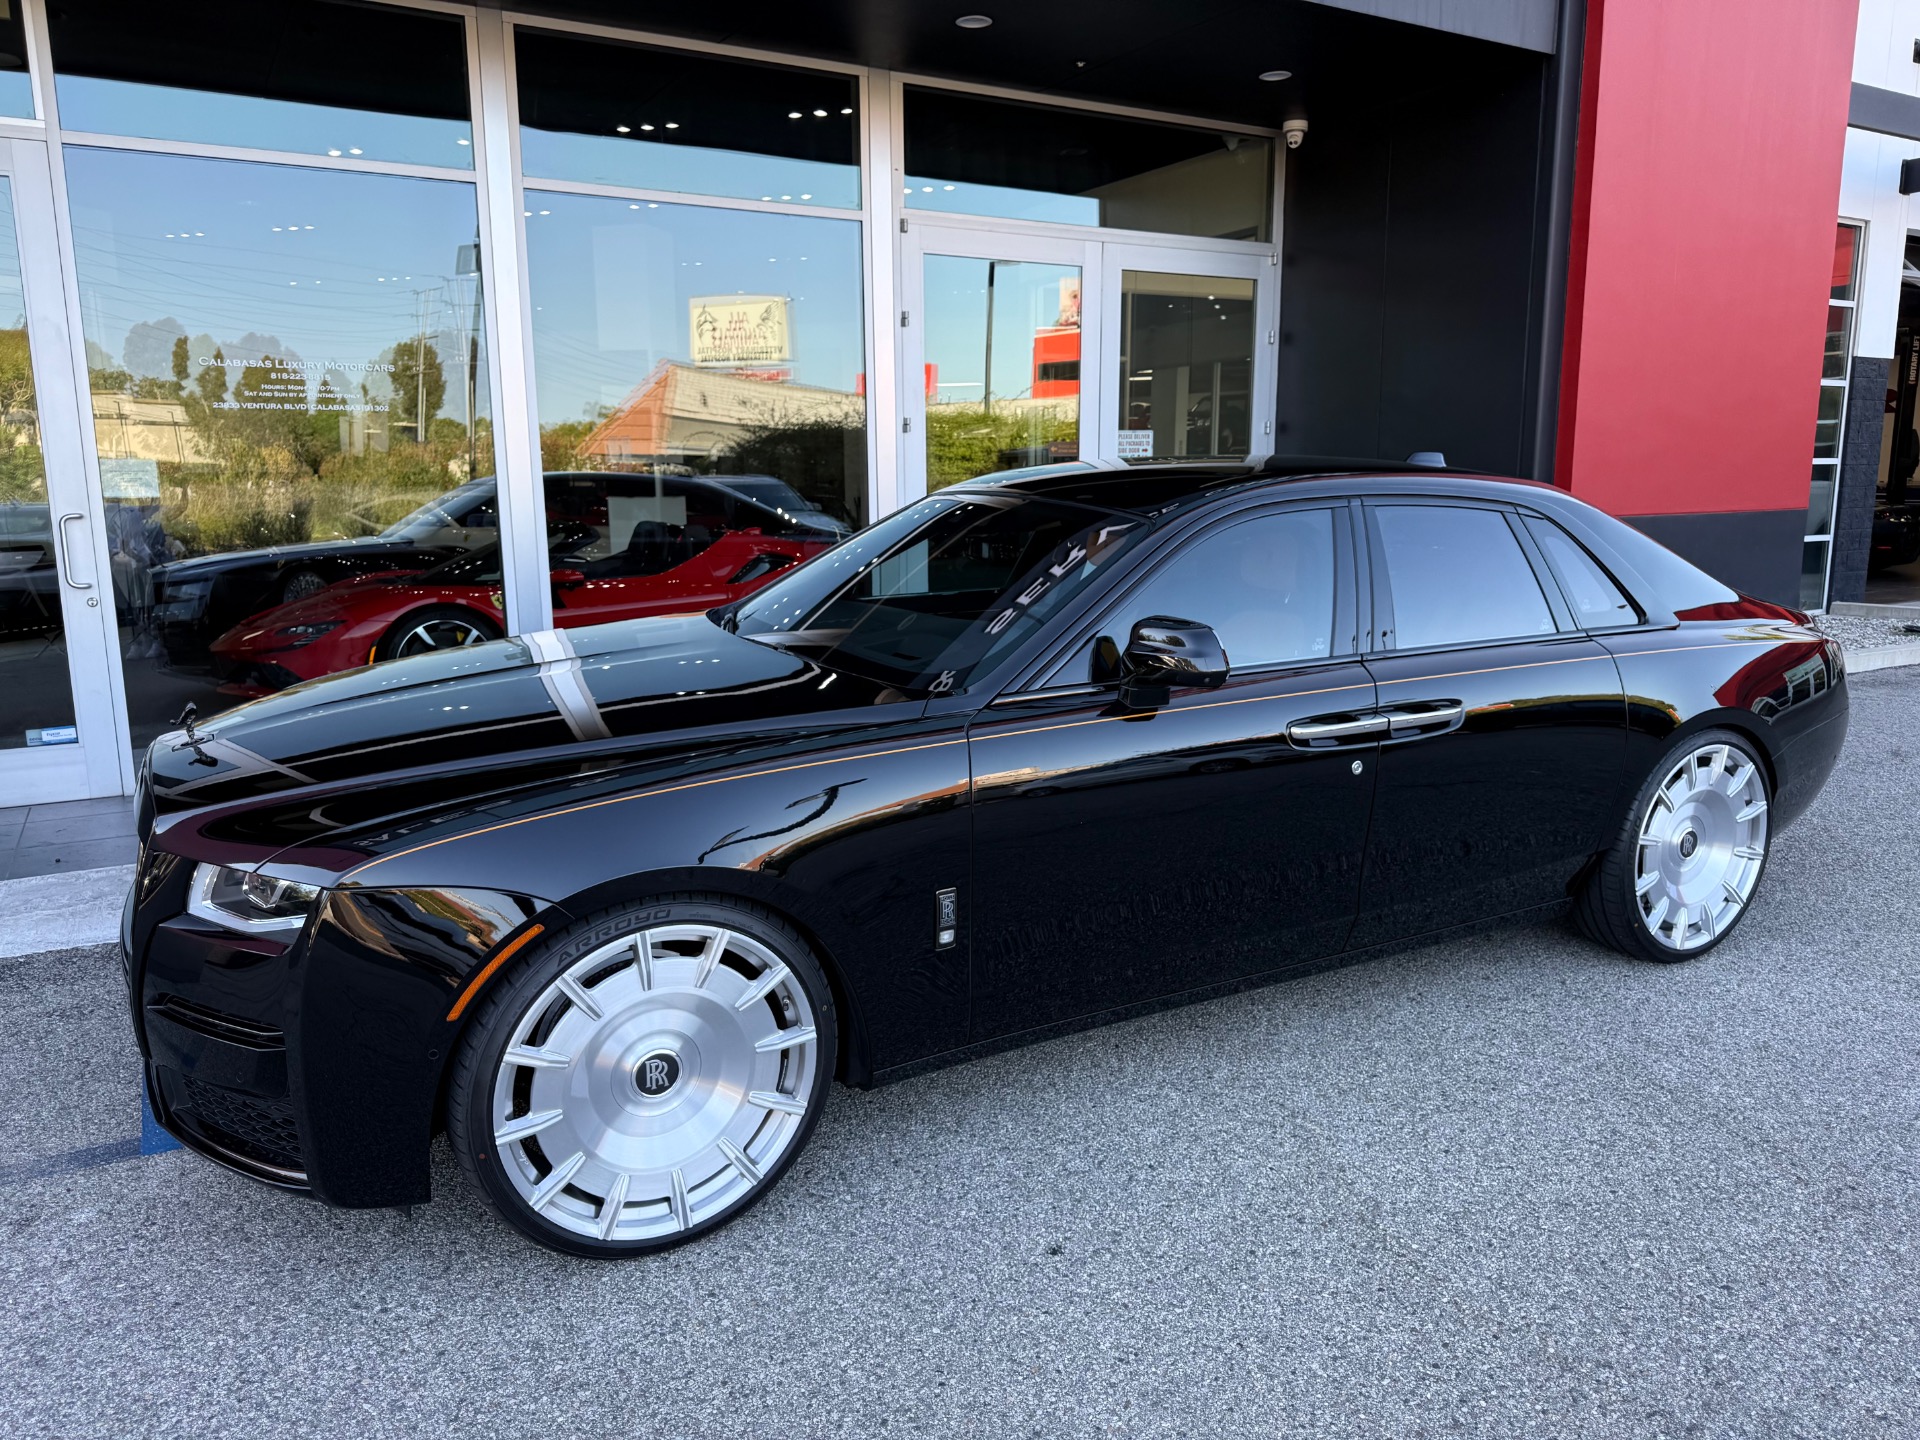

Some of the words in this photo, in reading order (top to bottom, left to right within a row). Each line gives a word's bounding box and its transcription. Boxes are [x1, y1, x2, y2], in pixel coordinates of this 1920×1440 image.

[198, 356, 272, 369] CALABASAS
[274, 359, 322, 371] LUXURY
[323, 360, 395, 374] MOTORCARS
[241, 402, 282, 410] VENTURA
[284, 403, 306, 411] BLVD
[556, 908, 672, 968] ARROYO
[644, 1058, 670, 1091] RR
